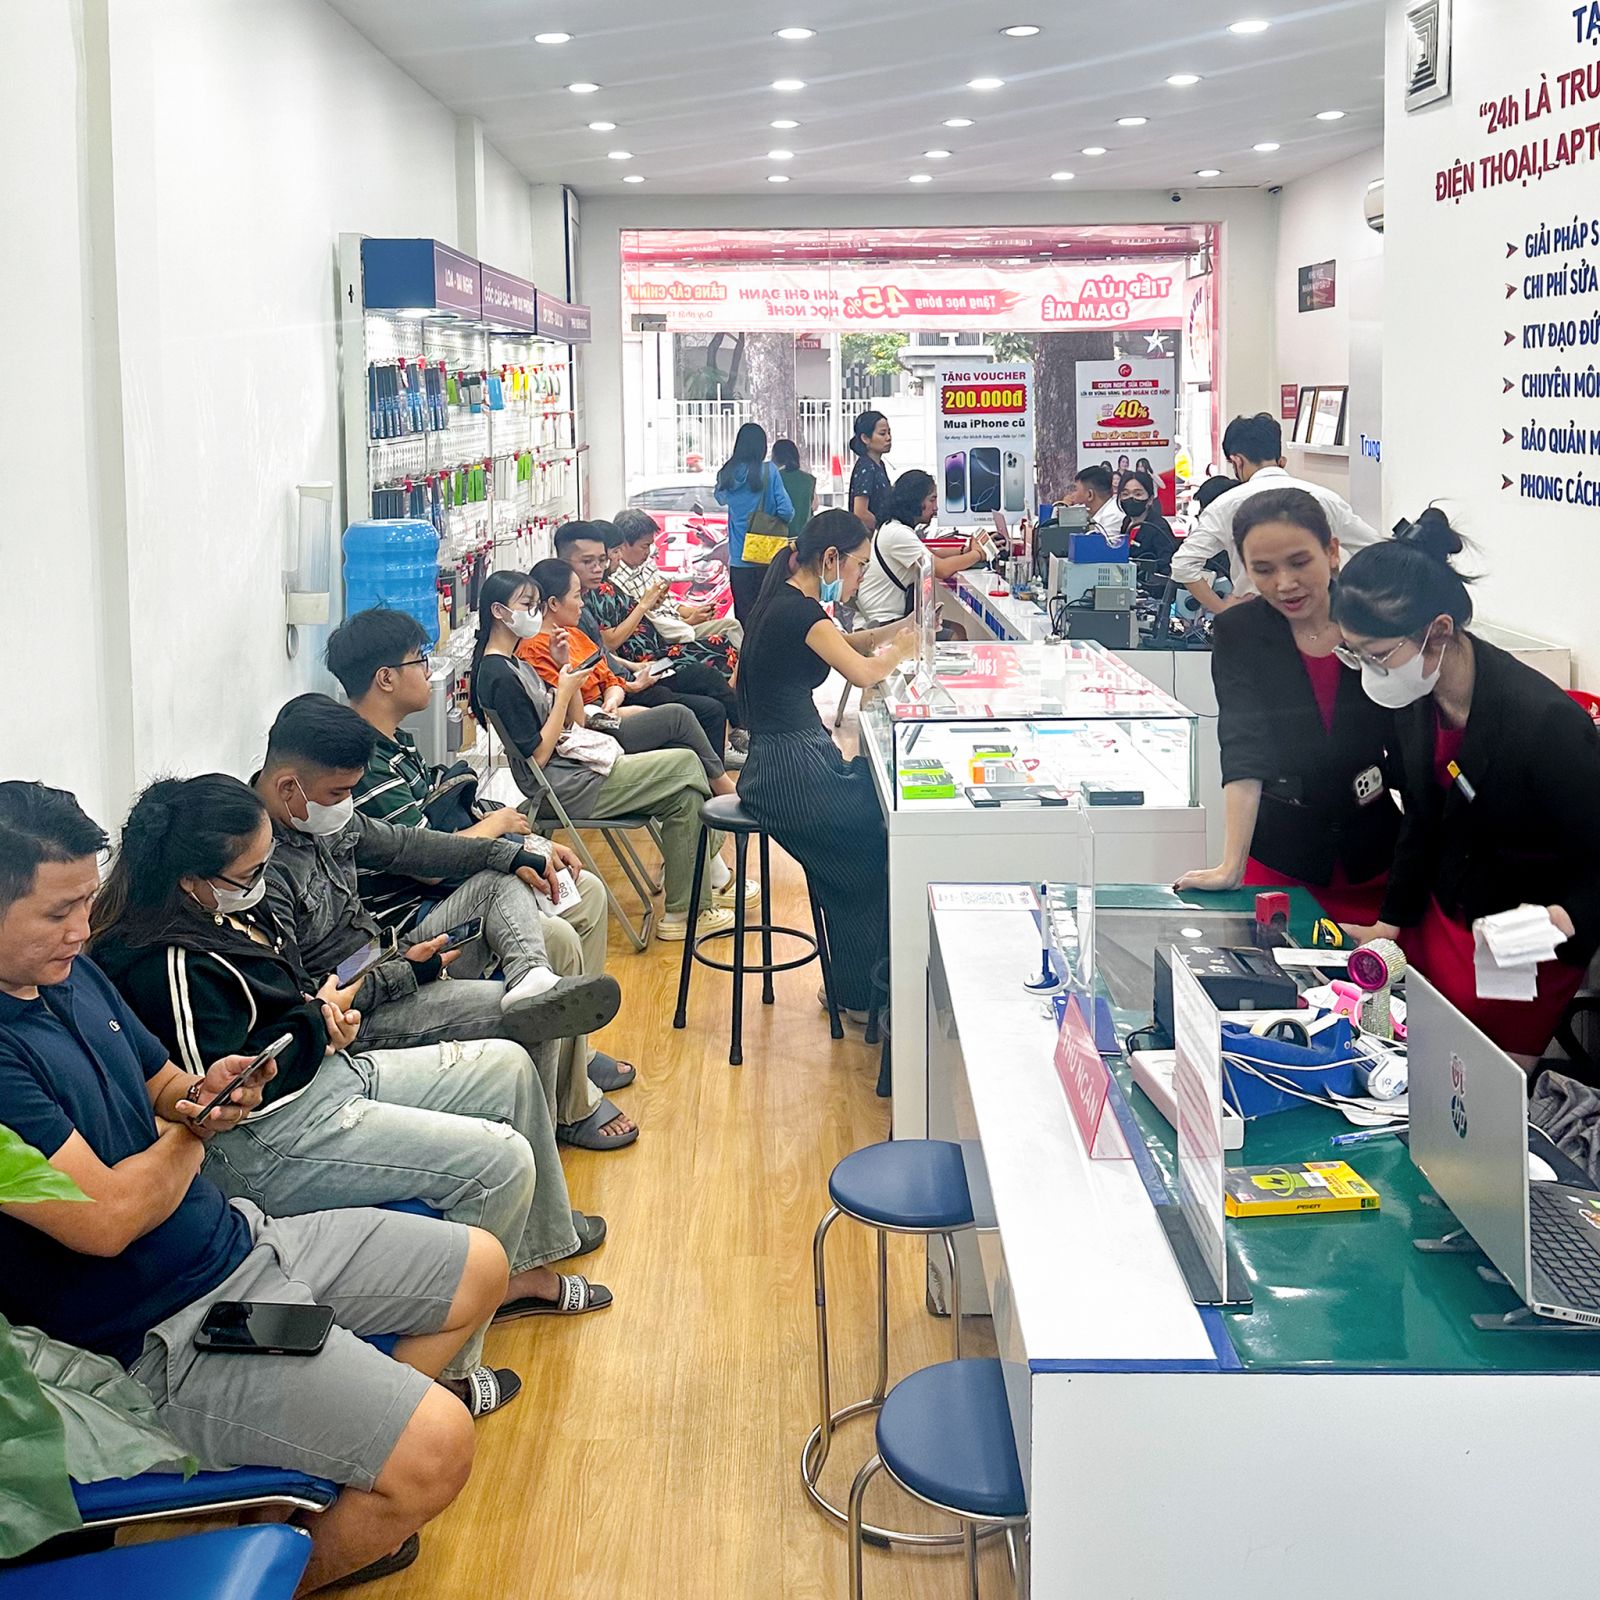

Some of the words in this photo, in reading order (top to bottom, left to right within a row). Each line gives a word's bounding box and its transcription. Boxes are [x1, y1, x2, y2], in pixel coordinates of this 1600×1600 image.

[1525, 73, 1551, 121] LÀ
[1435, 158, 1475, 204] ĐIỆN
[1525, 222, 1550, 258] GIẢI
[1554, 215, 1588, 253] PHÁP
[1524, 275, 1543, 300] CHI
[1547, 262, 1568, 297] PHÍ
[1570, 258, 1598, 294] SỬA
[1523, 323, 1546, 348] KTV
[1548, 321, 1576, 352] ĐẠO
[942, 371, 971, 383] TẶNG
[973, 371, 1026, 381] VOUCHER
[1521, 366, 1570, 398] CHUYÊN
[945, 390, 1023, 409] 200.000đ
[1115, 400, 1148, 418] 40%
[943, 420, 967, 429] Mua
[970, 418, 1009, 428] iPhone
[1011, 418, 1026, 427] cũ
[1521, 419, 1546, 451] BẢO
[1549, 420, 1586, 455] QUẢN
[1360, 434, 1381, 462] Trung
[1520, 473, 1563, 502] PHONG
[1566, 471, 1600, 507] CÁCH
[1075, 1060, 1099, 1126] NGÂN
